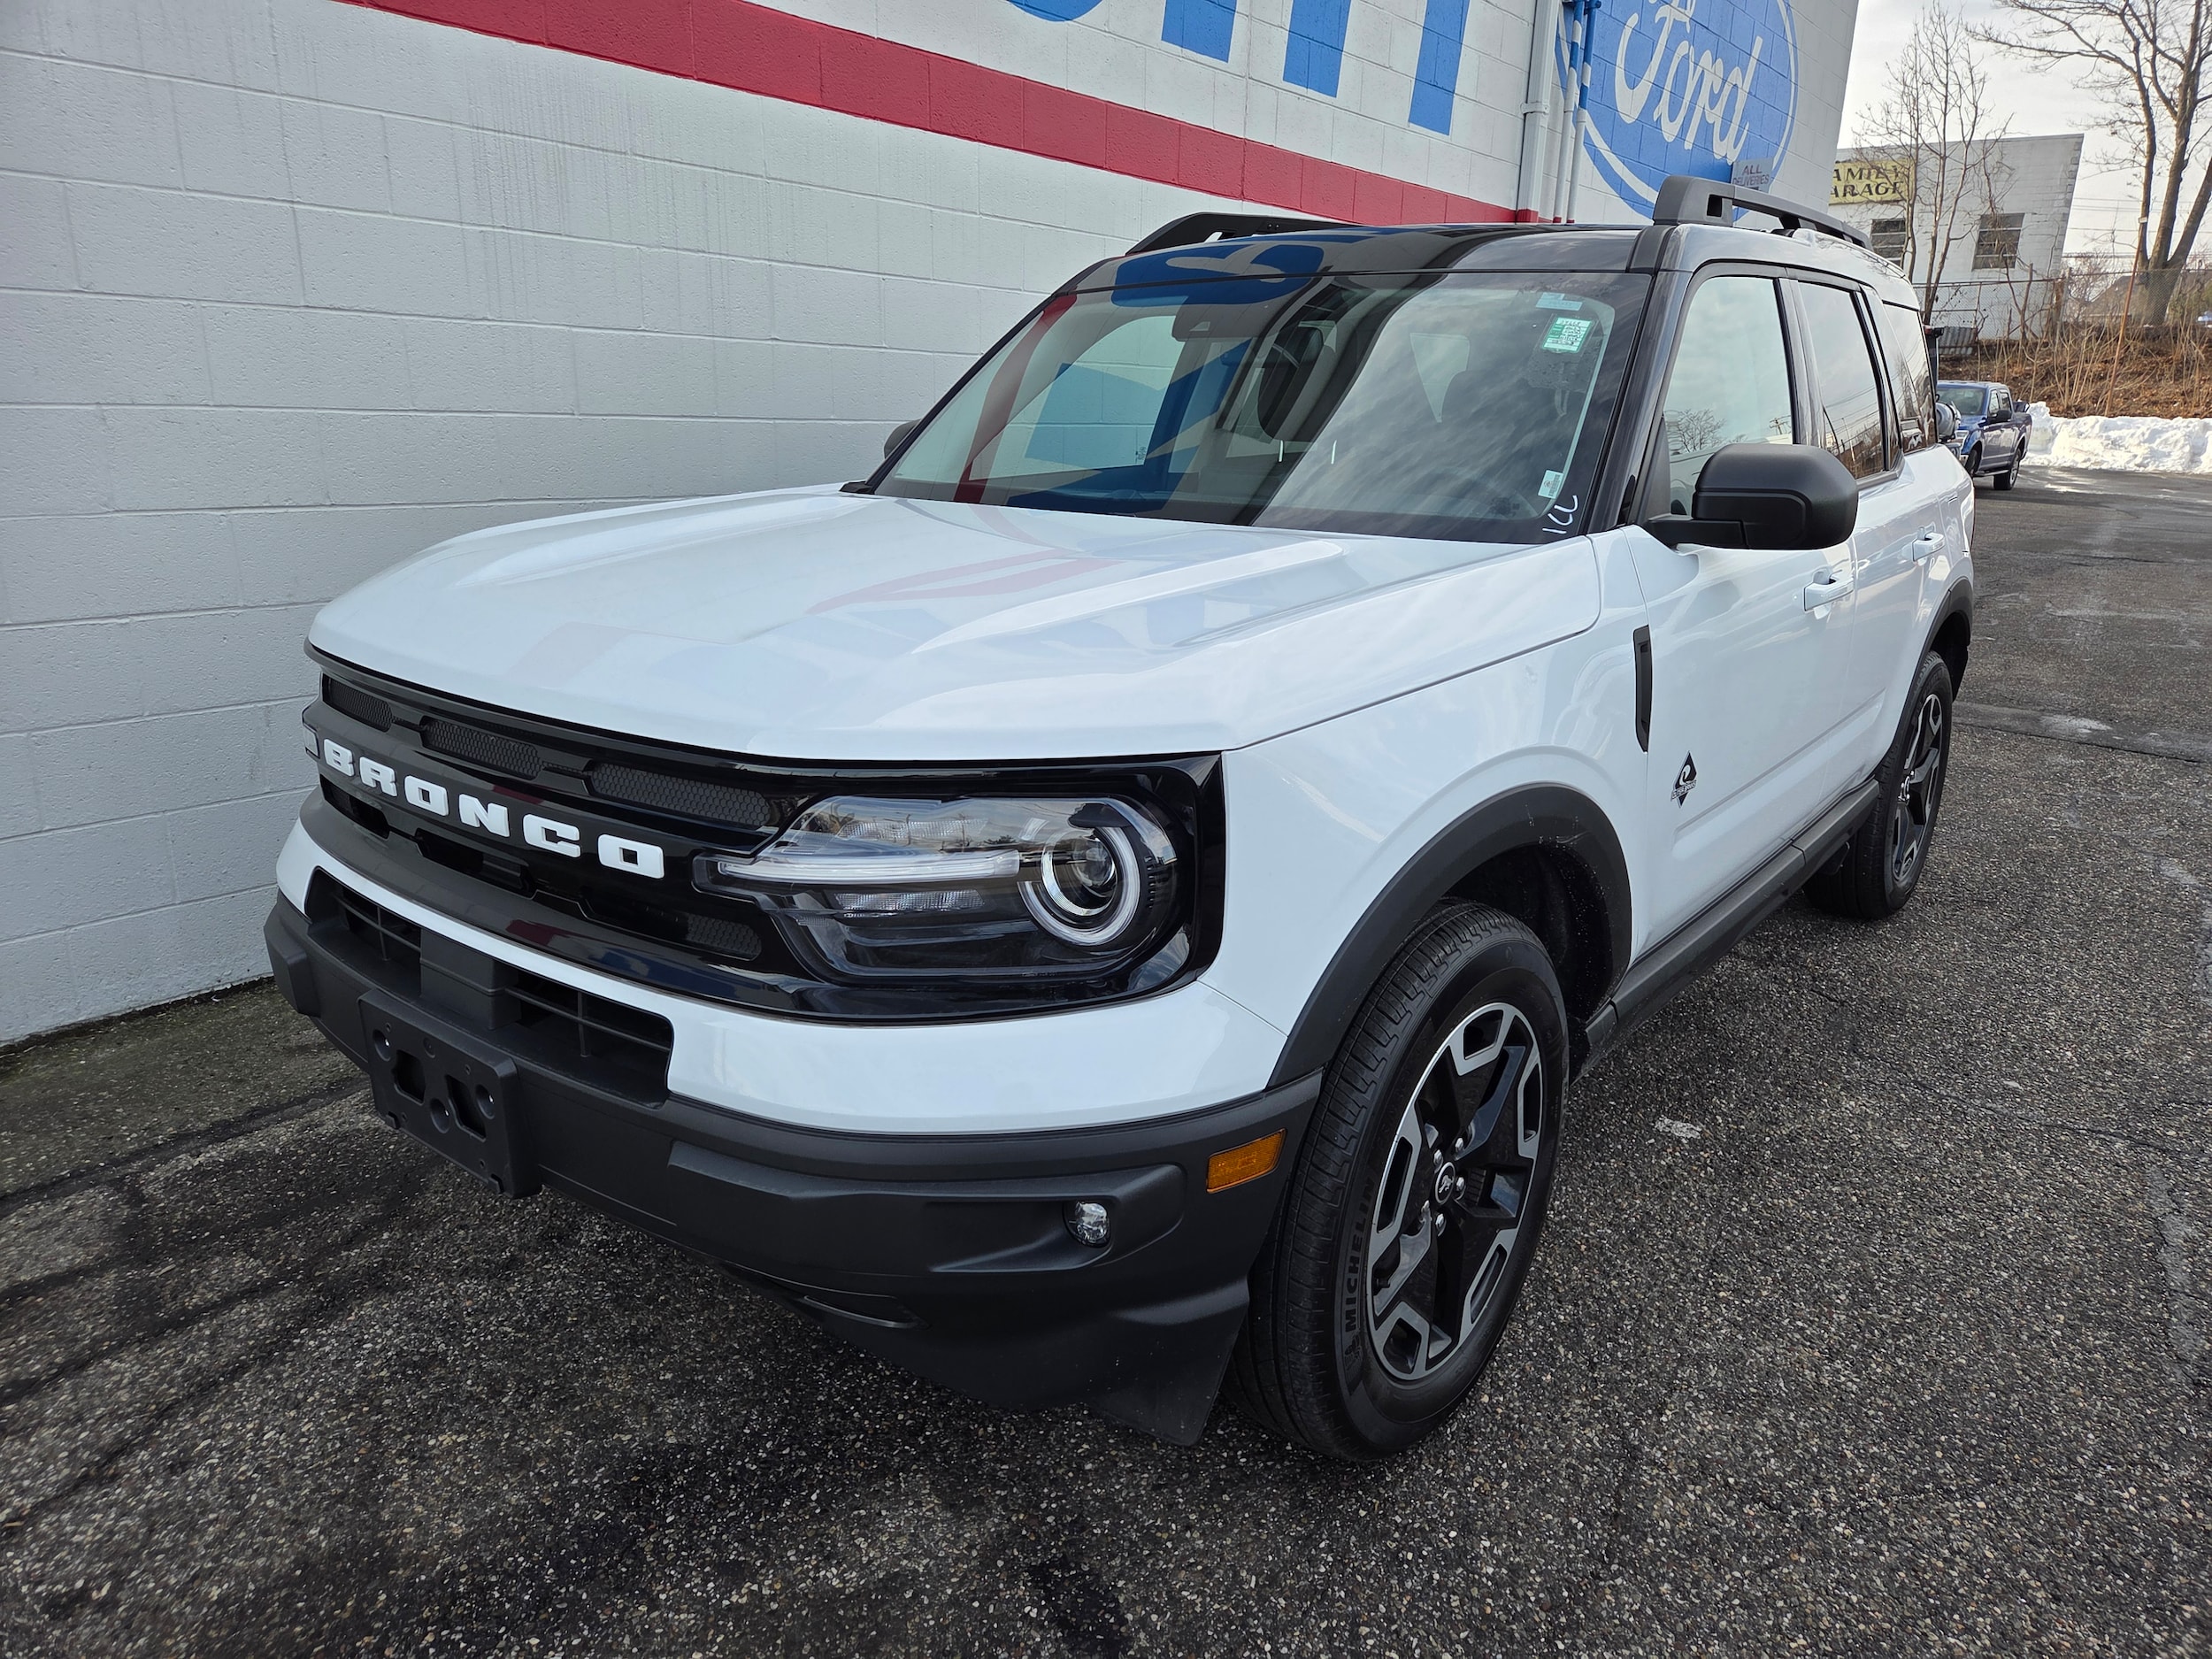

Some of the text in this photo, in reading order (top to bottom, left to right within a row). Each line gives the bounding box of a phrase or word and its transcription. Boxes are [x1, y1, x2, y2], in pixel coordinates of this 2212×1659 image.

[1615, 0, 1763, 165] Ford
[1742, 164, 1763, 175] ALL
[1830, 180, 1904, 197] ARAGE
[1832, 165, 1905, 182] AMILY
[324, 738, 664, 879] BRONCO
[1345, 1178, 1375, 1333] MICHELIN
